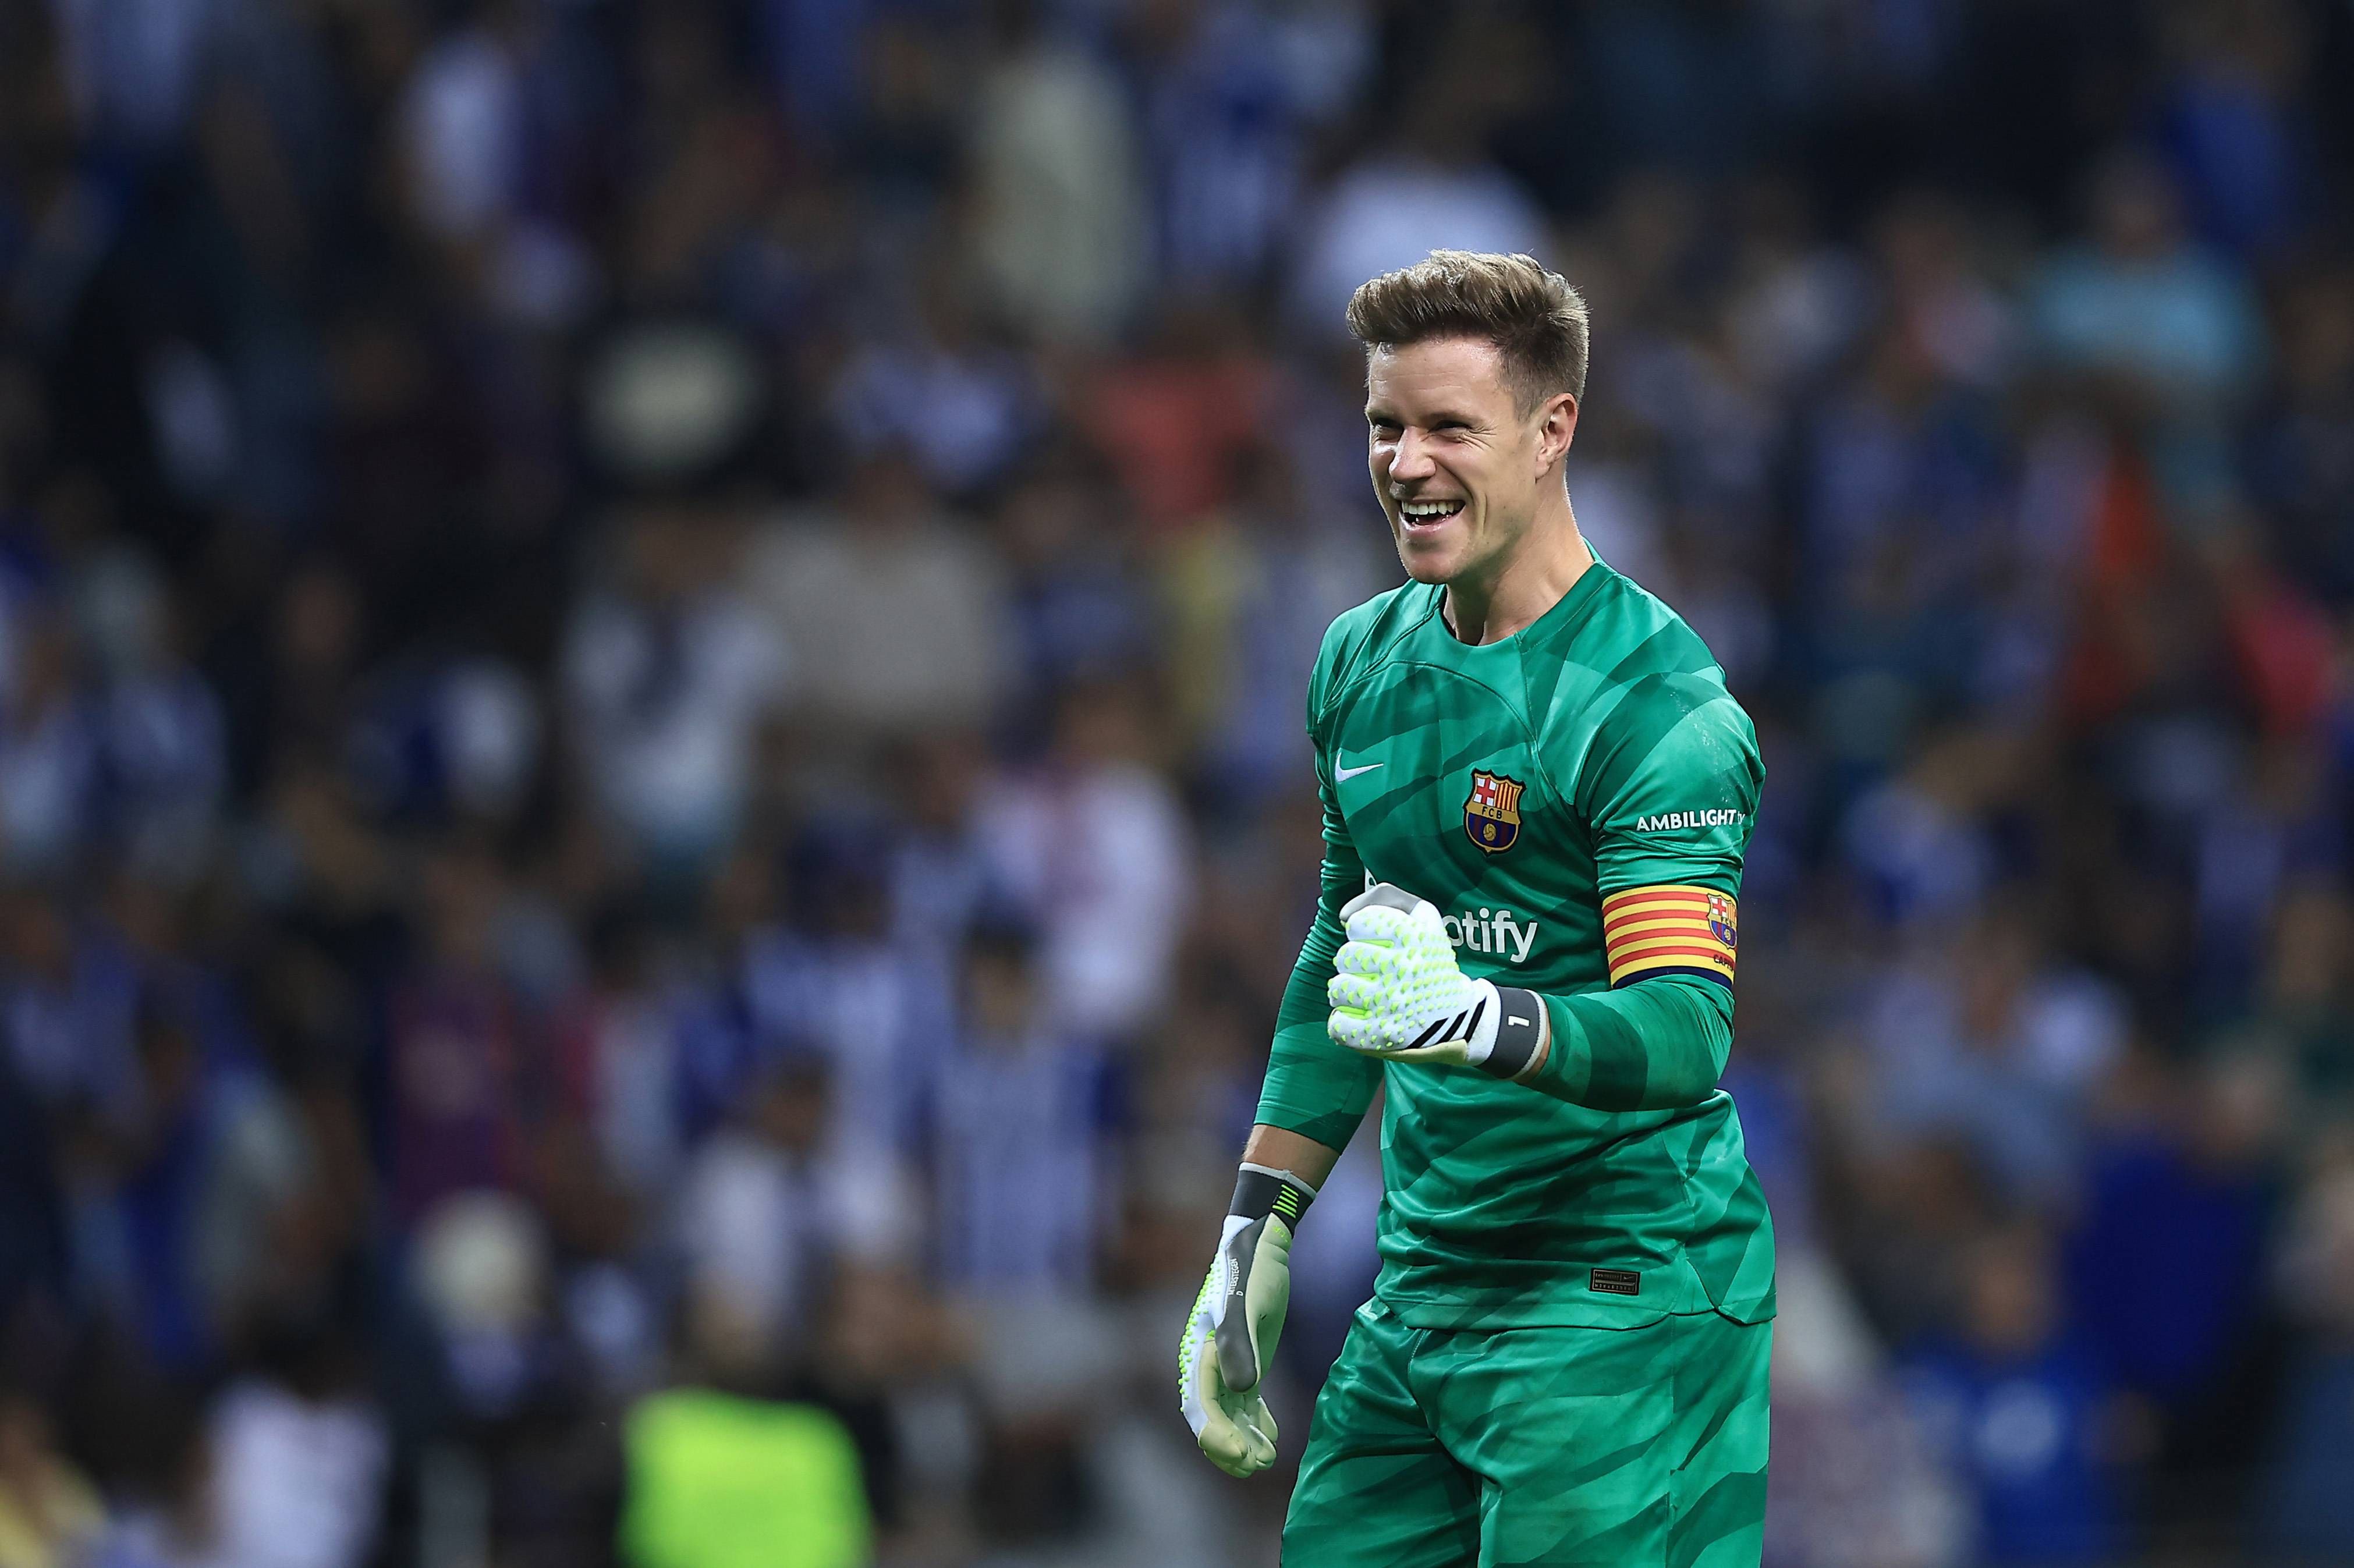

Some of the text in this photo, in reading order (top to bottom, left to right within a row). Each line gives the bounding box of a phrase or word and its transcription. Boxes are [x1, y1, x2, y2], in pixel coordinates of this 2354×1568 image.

[1481, 806, 1502, 819] FCB
[1636, 809, 1737, 832] AMBILIGHT
[1442, 908, 1538, 963] otify
[1508, 1015, 1530, 1027] 1
